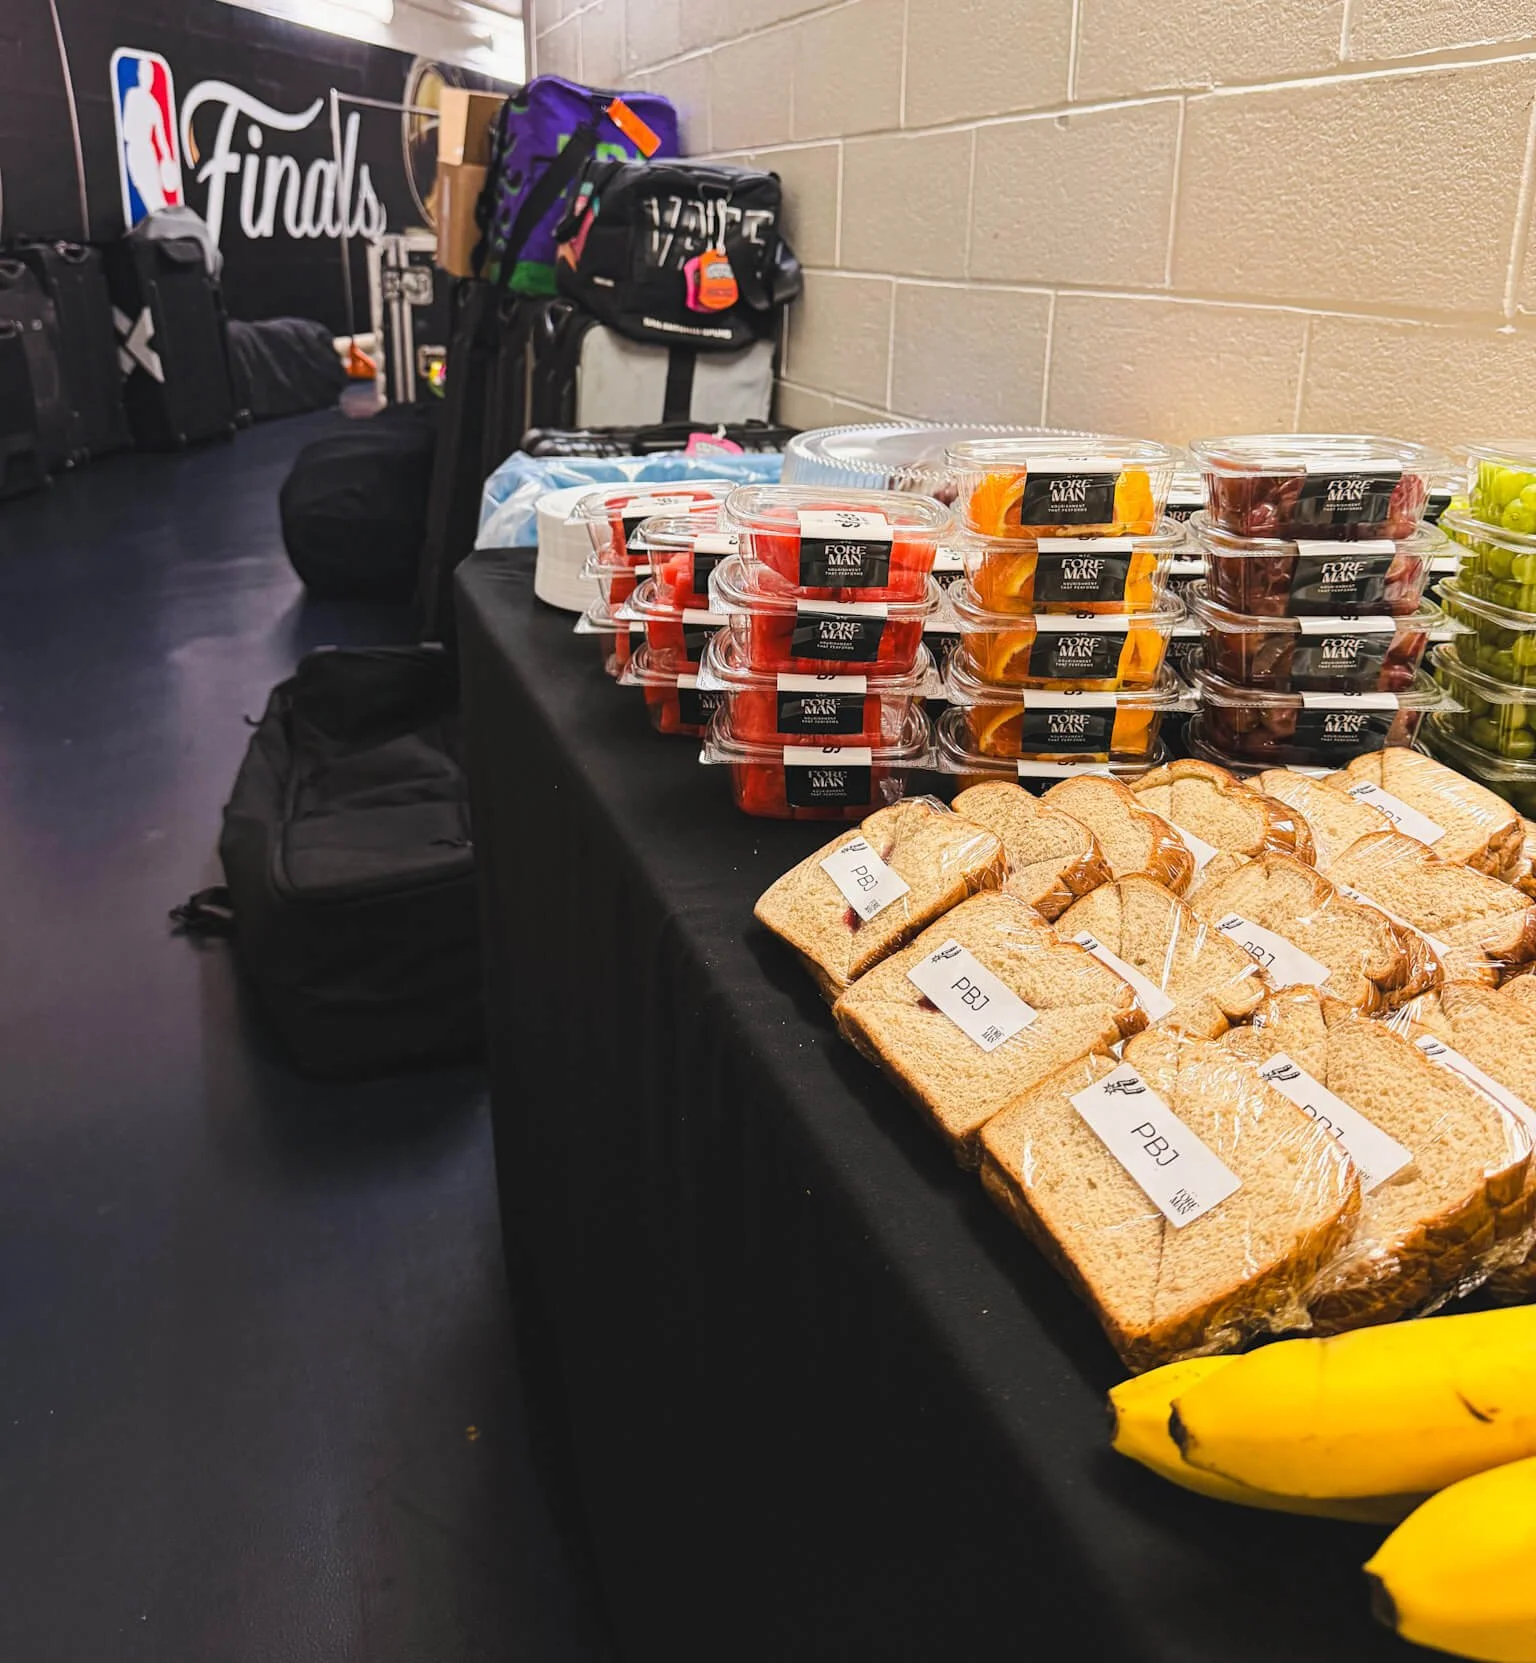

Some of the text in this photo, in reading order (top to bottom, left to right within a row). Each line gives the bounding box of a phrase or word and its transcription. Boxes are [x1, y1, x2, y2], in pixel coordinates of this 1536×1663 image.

[180, 79, 387, 250] Finals
[1049, 479, 1094, 490] FORE
[1327, 480, 1375, 490] FORE
[1051, 488, 1086, 502] MAN
[1327, 489, 1364, 501] MAN
[825, 545, 868, 555] FORE
[828, 554, 861, 565] MAN
[1061, 559, 1105, 570] FORE
[1321, 561, 1368, 573] FORE
[1064, 568, 1099, 579] MAN
[1322, 571, 1358, 583] MAN
[819, 621, 862, 633] FORE
[821, 630, 855, 640] MAN
[1058, 637, 1102, 647] FORE
[1321, 638, 1368, 648] FORE
[1059, 645, 1095, 657] MAN
[1322, 647, 1358, 658] MAN
[801, 699, 841, 708] FORE
[804, 705, 837, 715] MAN
[1048, 714, 1091, 724] FORE
[1324, 713, 1370, 725] FORE
[1051, 723, 1085, 733] MAN
[1325, 721, 1361, 733] MAN
[812, 778, 844, 788] MAN
[850, 865, 879, 892] PBJ
[951, 976, 990, 1011] PBJ
[1130, 1122, 1180, 1166] PBJ
